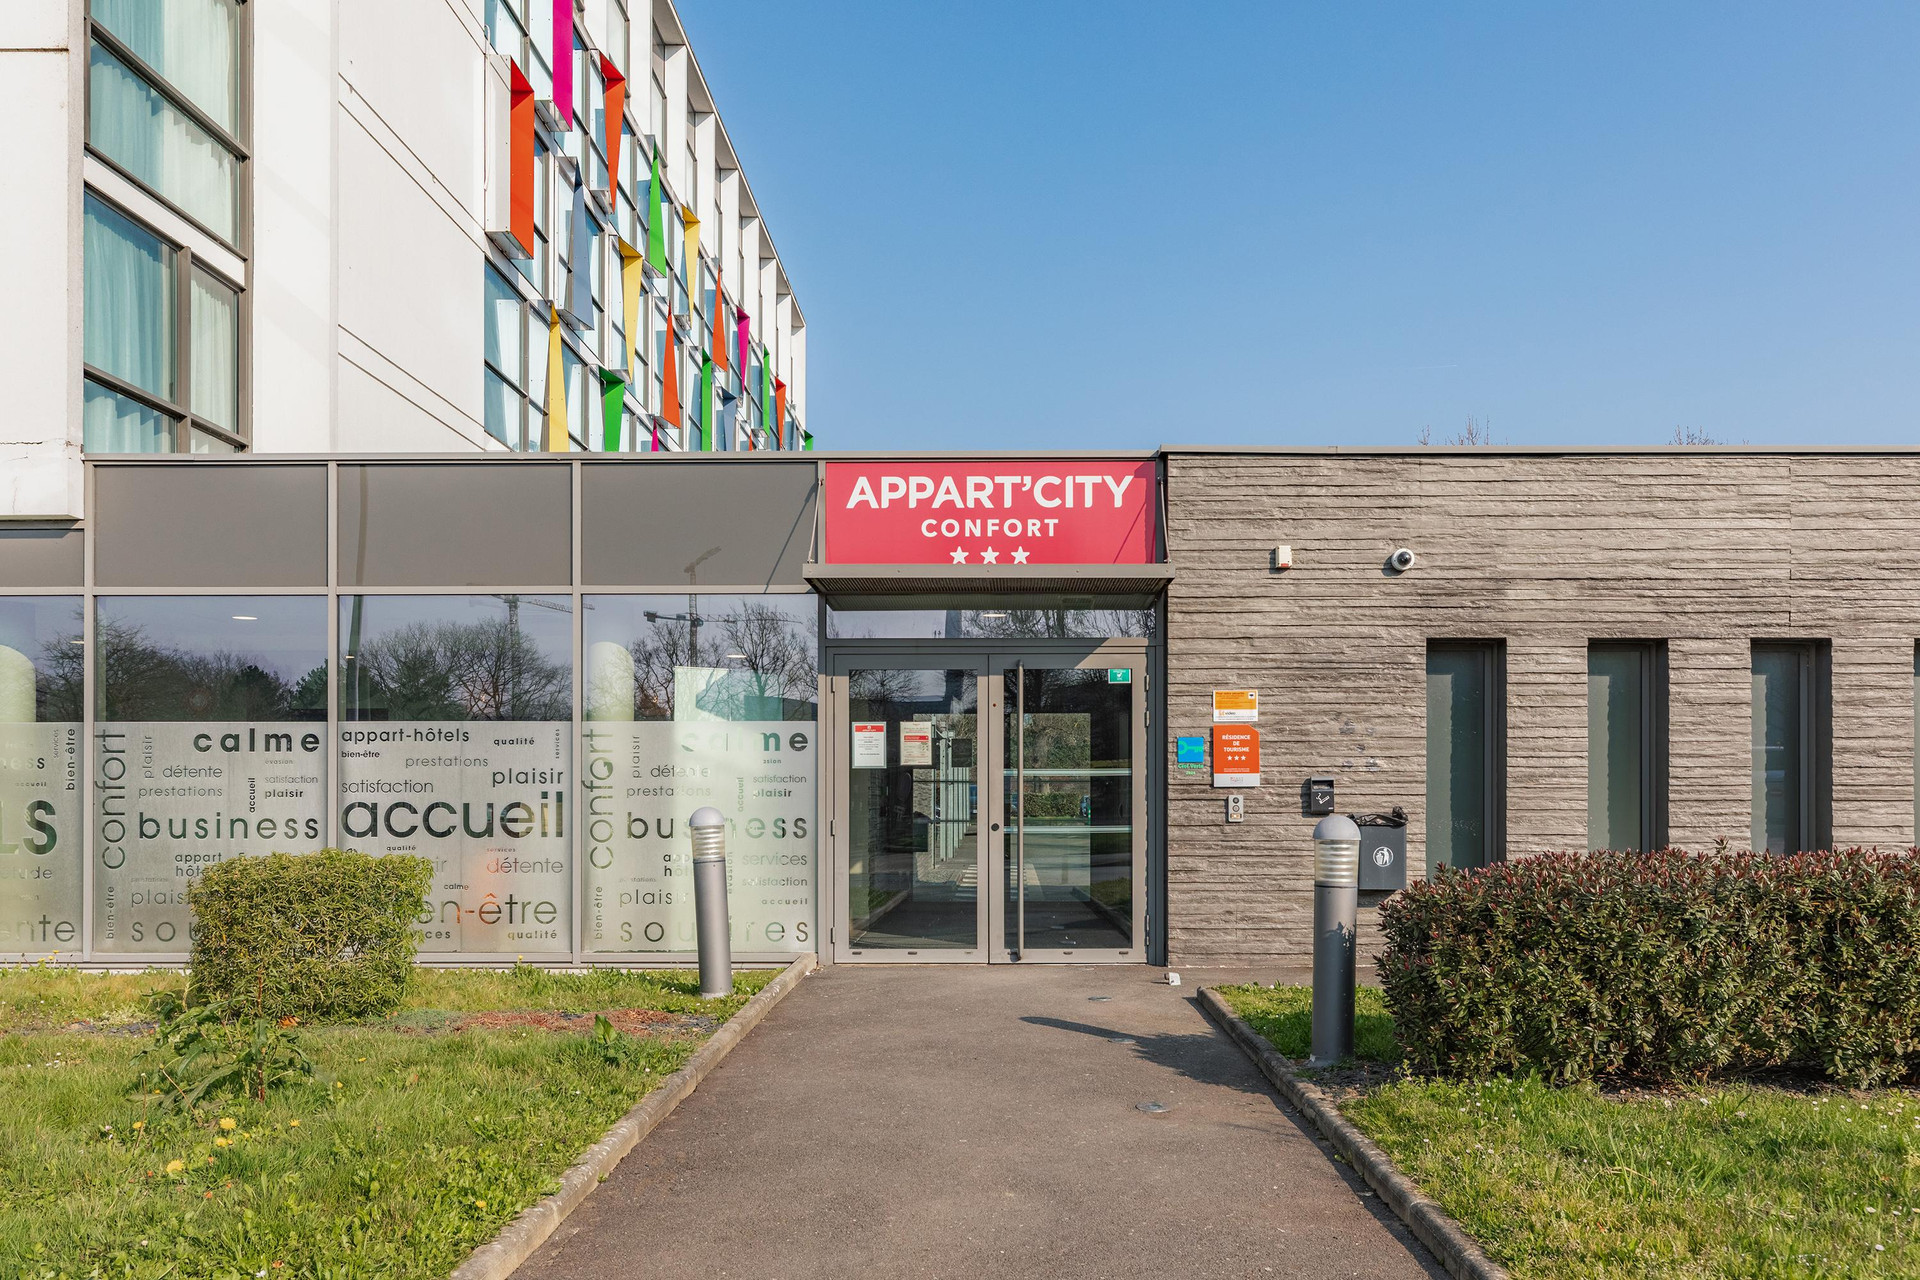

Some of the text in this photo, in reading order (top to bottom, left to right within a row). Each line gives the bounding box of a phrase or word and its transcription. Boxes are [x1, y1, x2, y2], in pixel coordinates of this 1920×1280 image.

[845, 475, 1135, 509] APPART'CITY
[921, 518, 1059, 538] CONFORT
[193, 728, 320, 752] calme
[341, 728, 470, 745] appart-hôtels
[493, 737, 535, 747] qualité
[65, 728, 75, 790] bien-être
[143, 735, 154, 779] plaisir
[341, 750, 380, 759] bien-être
[405, 756, 489, 769] prestations
[632, 735, 643, 778] plaisir
[162, 765, 223, 779] détente
[264, 775, 319, 784] satisfaction
[492, 768, 564, 788] plaisir
[752, 774, 807, 784] satisfaction
[138, 786, 223, 799] prestations
[248, 777, 256, 813] accueil
[264, 788, 304, 799] plaisir
[341, 779, 434, 794] satisfaction
[736, 776, 744, 812] accueil
[94, 728, 126, 870] confort
[581, 728, 614, 870] confort
[341, 791, 564, 839] accueil
[139, 812, 319, 840] business
[386, 844, 417, 852] qualité
[486, 857, 564, 874] détente
[742, 851, 808, 866] services
[443, 883, 470, 891] calme
[742, 876, 808, 887] satisfaction
[761, 897, 808, 905] accueil
[105, 886, 115, 939] bien-être
[594, 886, 603, 940] bien-être
[507, 929, 558, 941] qualité
